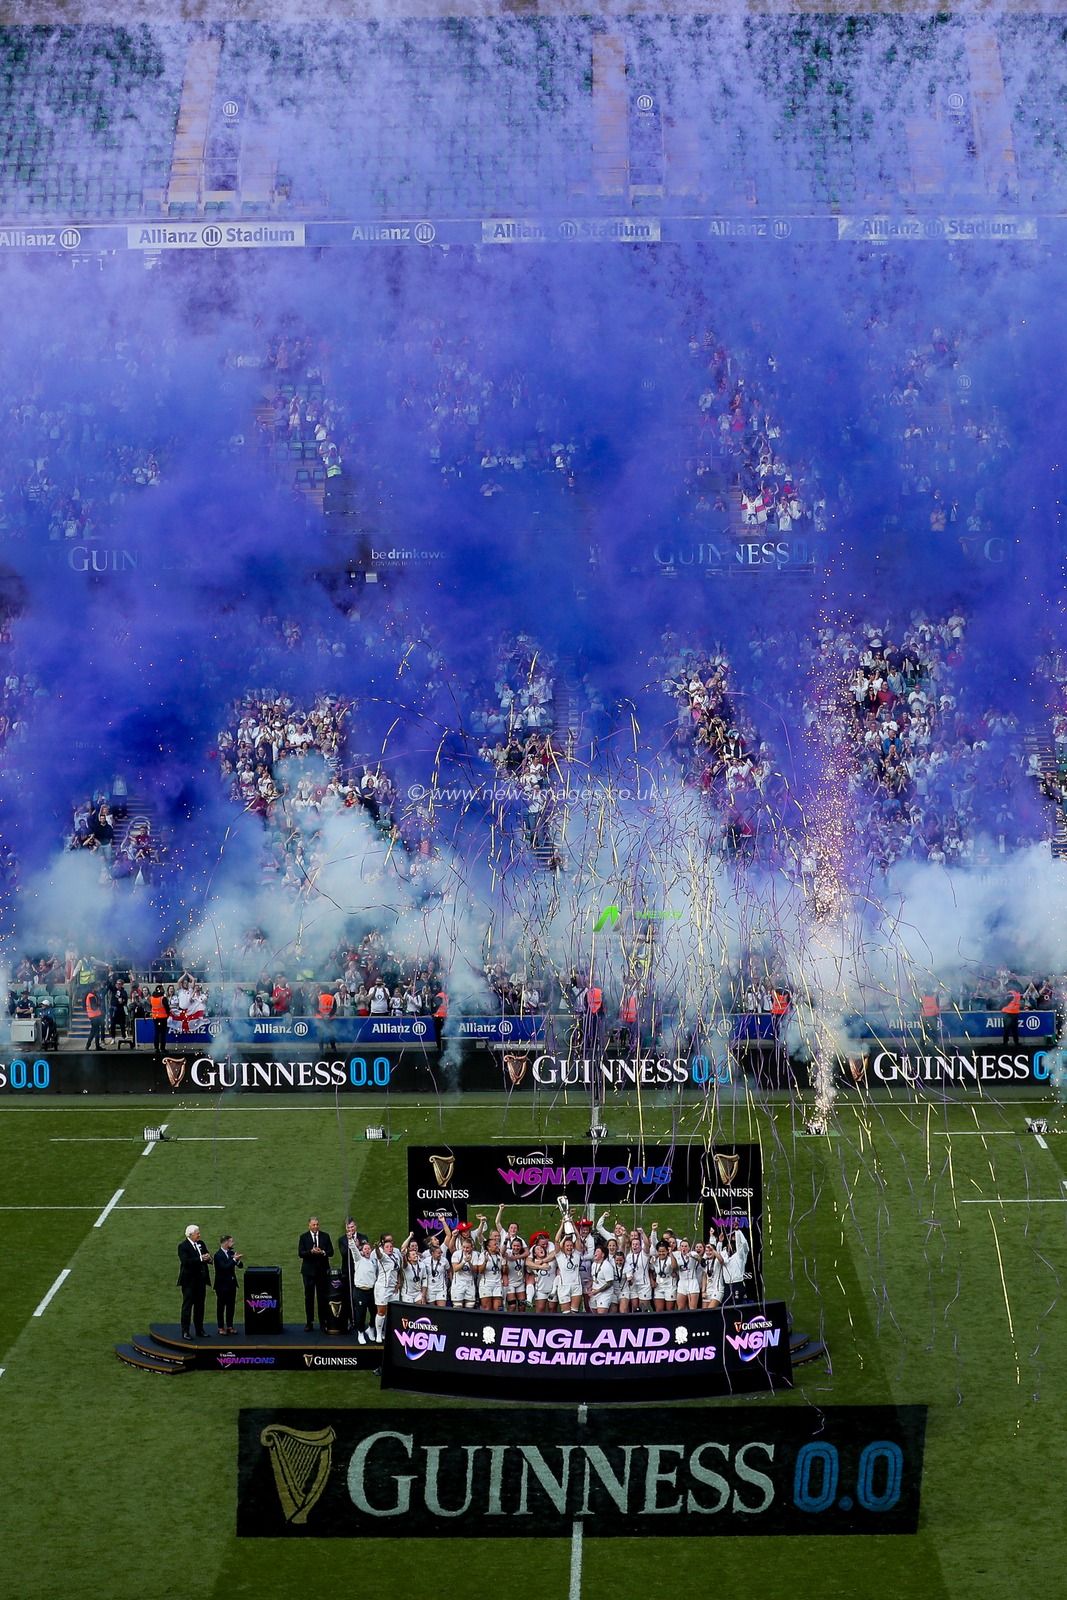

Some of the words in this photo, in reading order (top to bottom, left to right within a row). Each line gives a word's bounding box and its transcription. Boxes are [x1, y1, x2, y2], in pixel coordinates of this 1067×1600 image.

[351, 226, 410, 240] Allianz
[582, 222, 650, 237] Stadium
[709, 220, 767, 236] Allianz
[861, 220, 918, 235] Allianz
[947, 219, 1018, 234] Stadium
[0, 231, 55, 247] Allianz
[139, 229, 197, 244] Allianz
[226, 227, 295, 242] Stadium
[254, 1023, 292, 1034] Allianz
[371, 1022, 410, 1034] Allianz
[459, 1021, 497, 1033] Allianz
[985, 1017, 1024, 1028] Alliz
[10, 1060, 50, 1088] 0.0
[190, 1058, 347, 1087] GUINNESS
[350, 1057, 390, 1086] 0.0
[532, 1055, 689, 1085] GUINNESS
[873, 1052, 1030, 1081] GUINNESS
[516, 1156, 553, 1165] GUINNESS
[417, 1188, 470, 1199] GUINNESS
[702, 1186, 754, 1198] GUINNESS
[408, 1320, 438, 1332] GUINNESS
[741, 1320, 773, 1331] GUINNESS
[393, 1328, 447, 1352] W6N
[500, 1327, 671, 1349] ENGLAND
[725, 1328, 781, 1350] W6N
[313, 1356, 358, 1366] GUINNESS
[455, 1346, 526, 1364] GRAND
[527, 1350, 587, 1365] SLAM
[589, 1346, 717, 1366] CHAMPIONS
[347, 1430, 775, 1518] GUINNESS
[793, 1440, 904, 1513] 0.0
